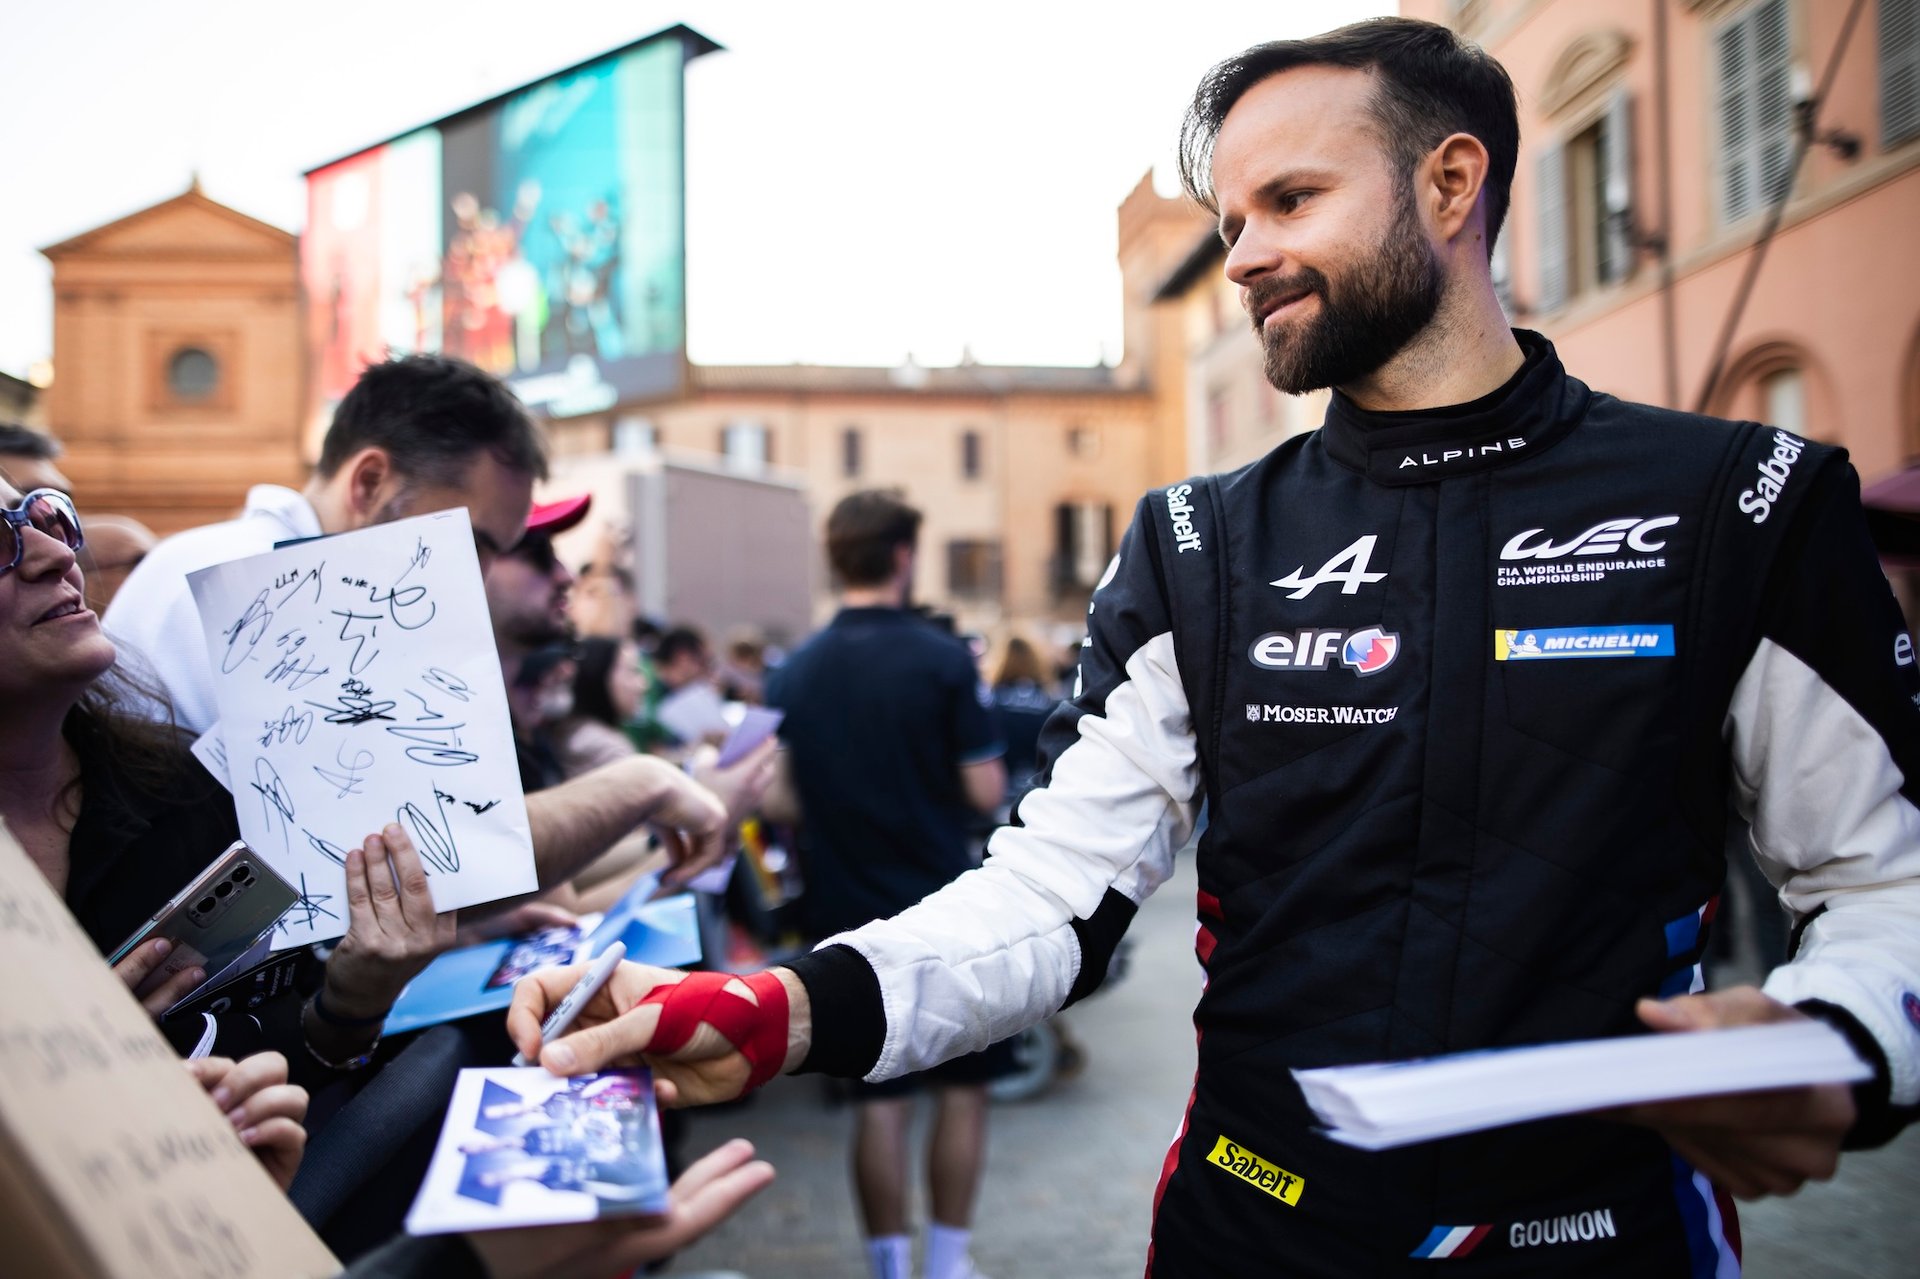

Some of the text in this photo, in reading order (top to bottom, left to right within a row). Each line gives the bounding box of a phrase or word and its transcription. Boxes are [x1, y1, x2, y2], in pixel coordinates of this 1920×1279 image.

[1398, 437, 1527, 469] ALPINE
[1738, 430, 1805, 524] Sabelt
[1166, 484, 1202, 553] Sabelt
[1499, 515, 1680, 560] WEC
[1497, 558, 1666, 577] FIA WORLD ENDURANCE
[1497, 572, 1605, 586] CHAMPIONSHIP
[1253, 632, 1343, 666] elf
[1543, 634, 1660, 650] MICHELIN
[1262, 704, 1399, 725] MOSER.WATCH
[1218, 1142, 1295, 1198] Sabelt
[1509, 1208, 1617, 1248] GOUNON
